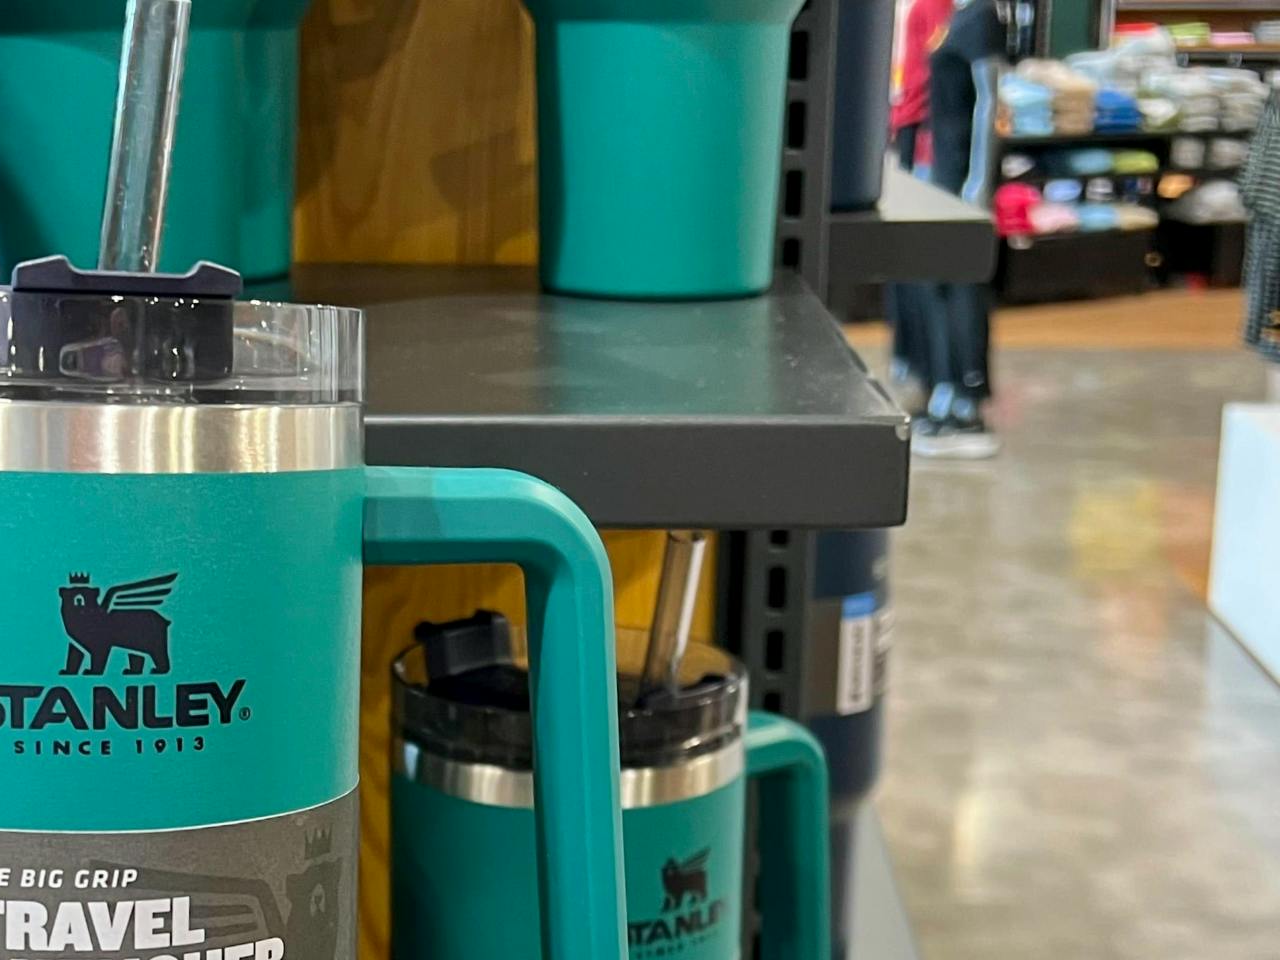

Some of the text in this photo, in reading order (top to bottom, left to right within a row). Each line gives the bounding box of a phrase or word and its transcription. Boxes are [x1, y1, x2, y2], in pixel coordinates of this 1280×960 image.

[14, 737, 204, 755] SINCE 1913
[20, 869, 63, 888] BIG
[74, 869, 138, 888] GRIP
